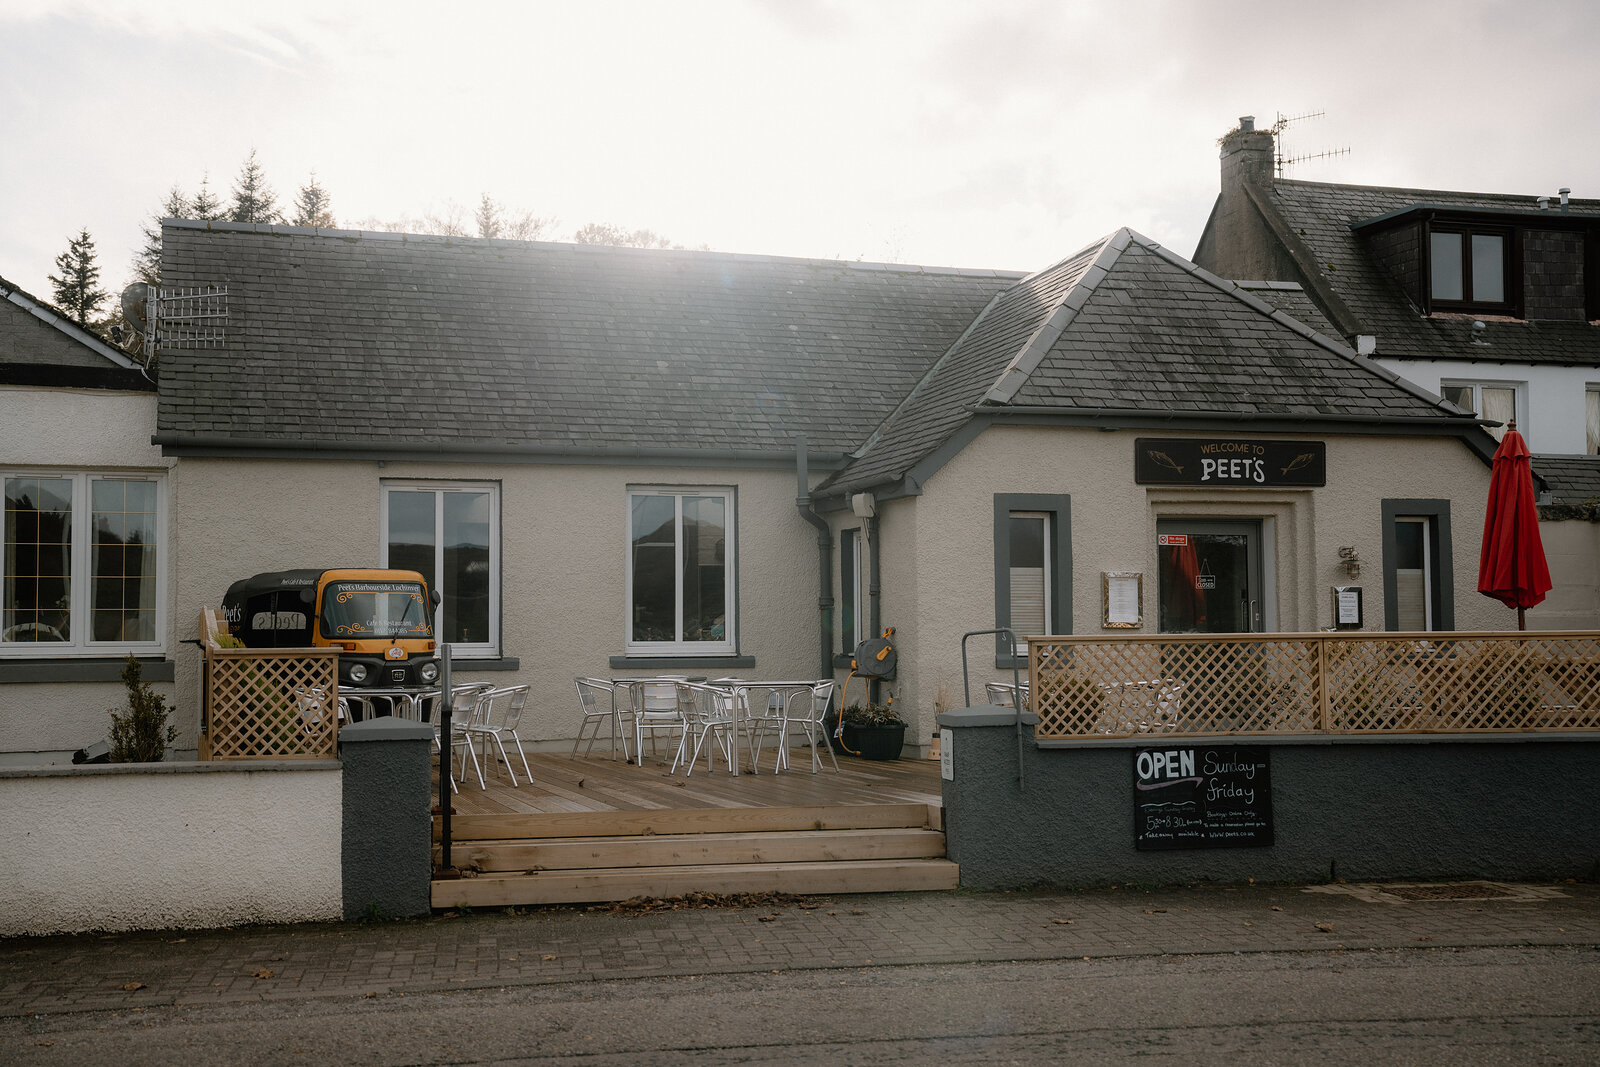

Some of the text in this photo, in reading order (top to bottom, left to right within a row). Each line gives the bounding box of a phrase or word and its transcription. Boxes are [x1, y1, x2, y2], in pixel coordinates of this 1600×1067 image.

[1201, 443, 1265, 455] WELCOME TO
[1200, 456, 1265, 483] PEET'S
[337, 584, 354, 592] Peet's
[1137, 749, 1195, 779] OPEN
